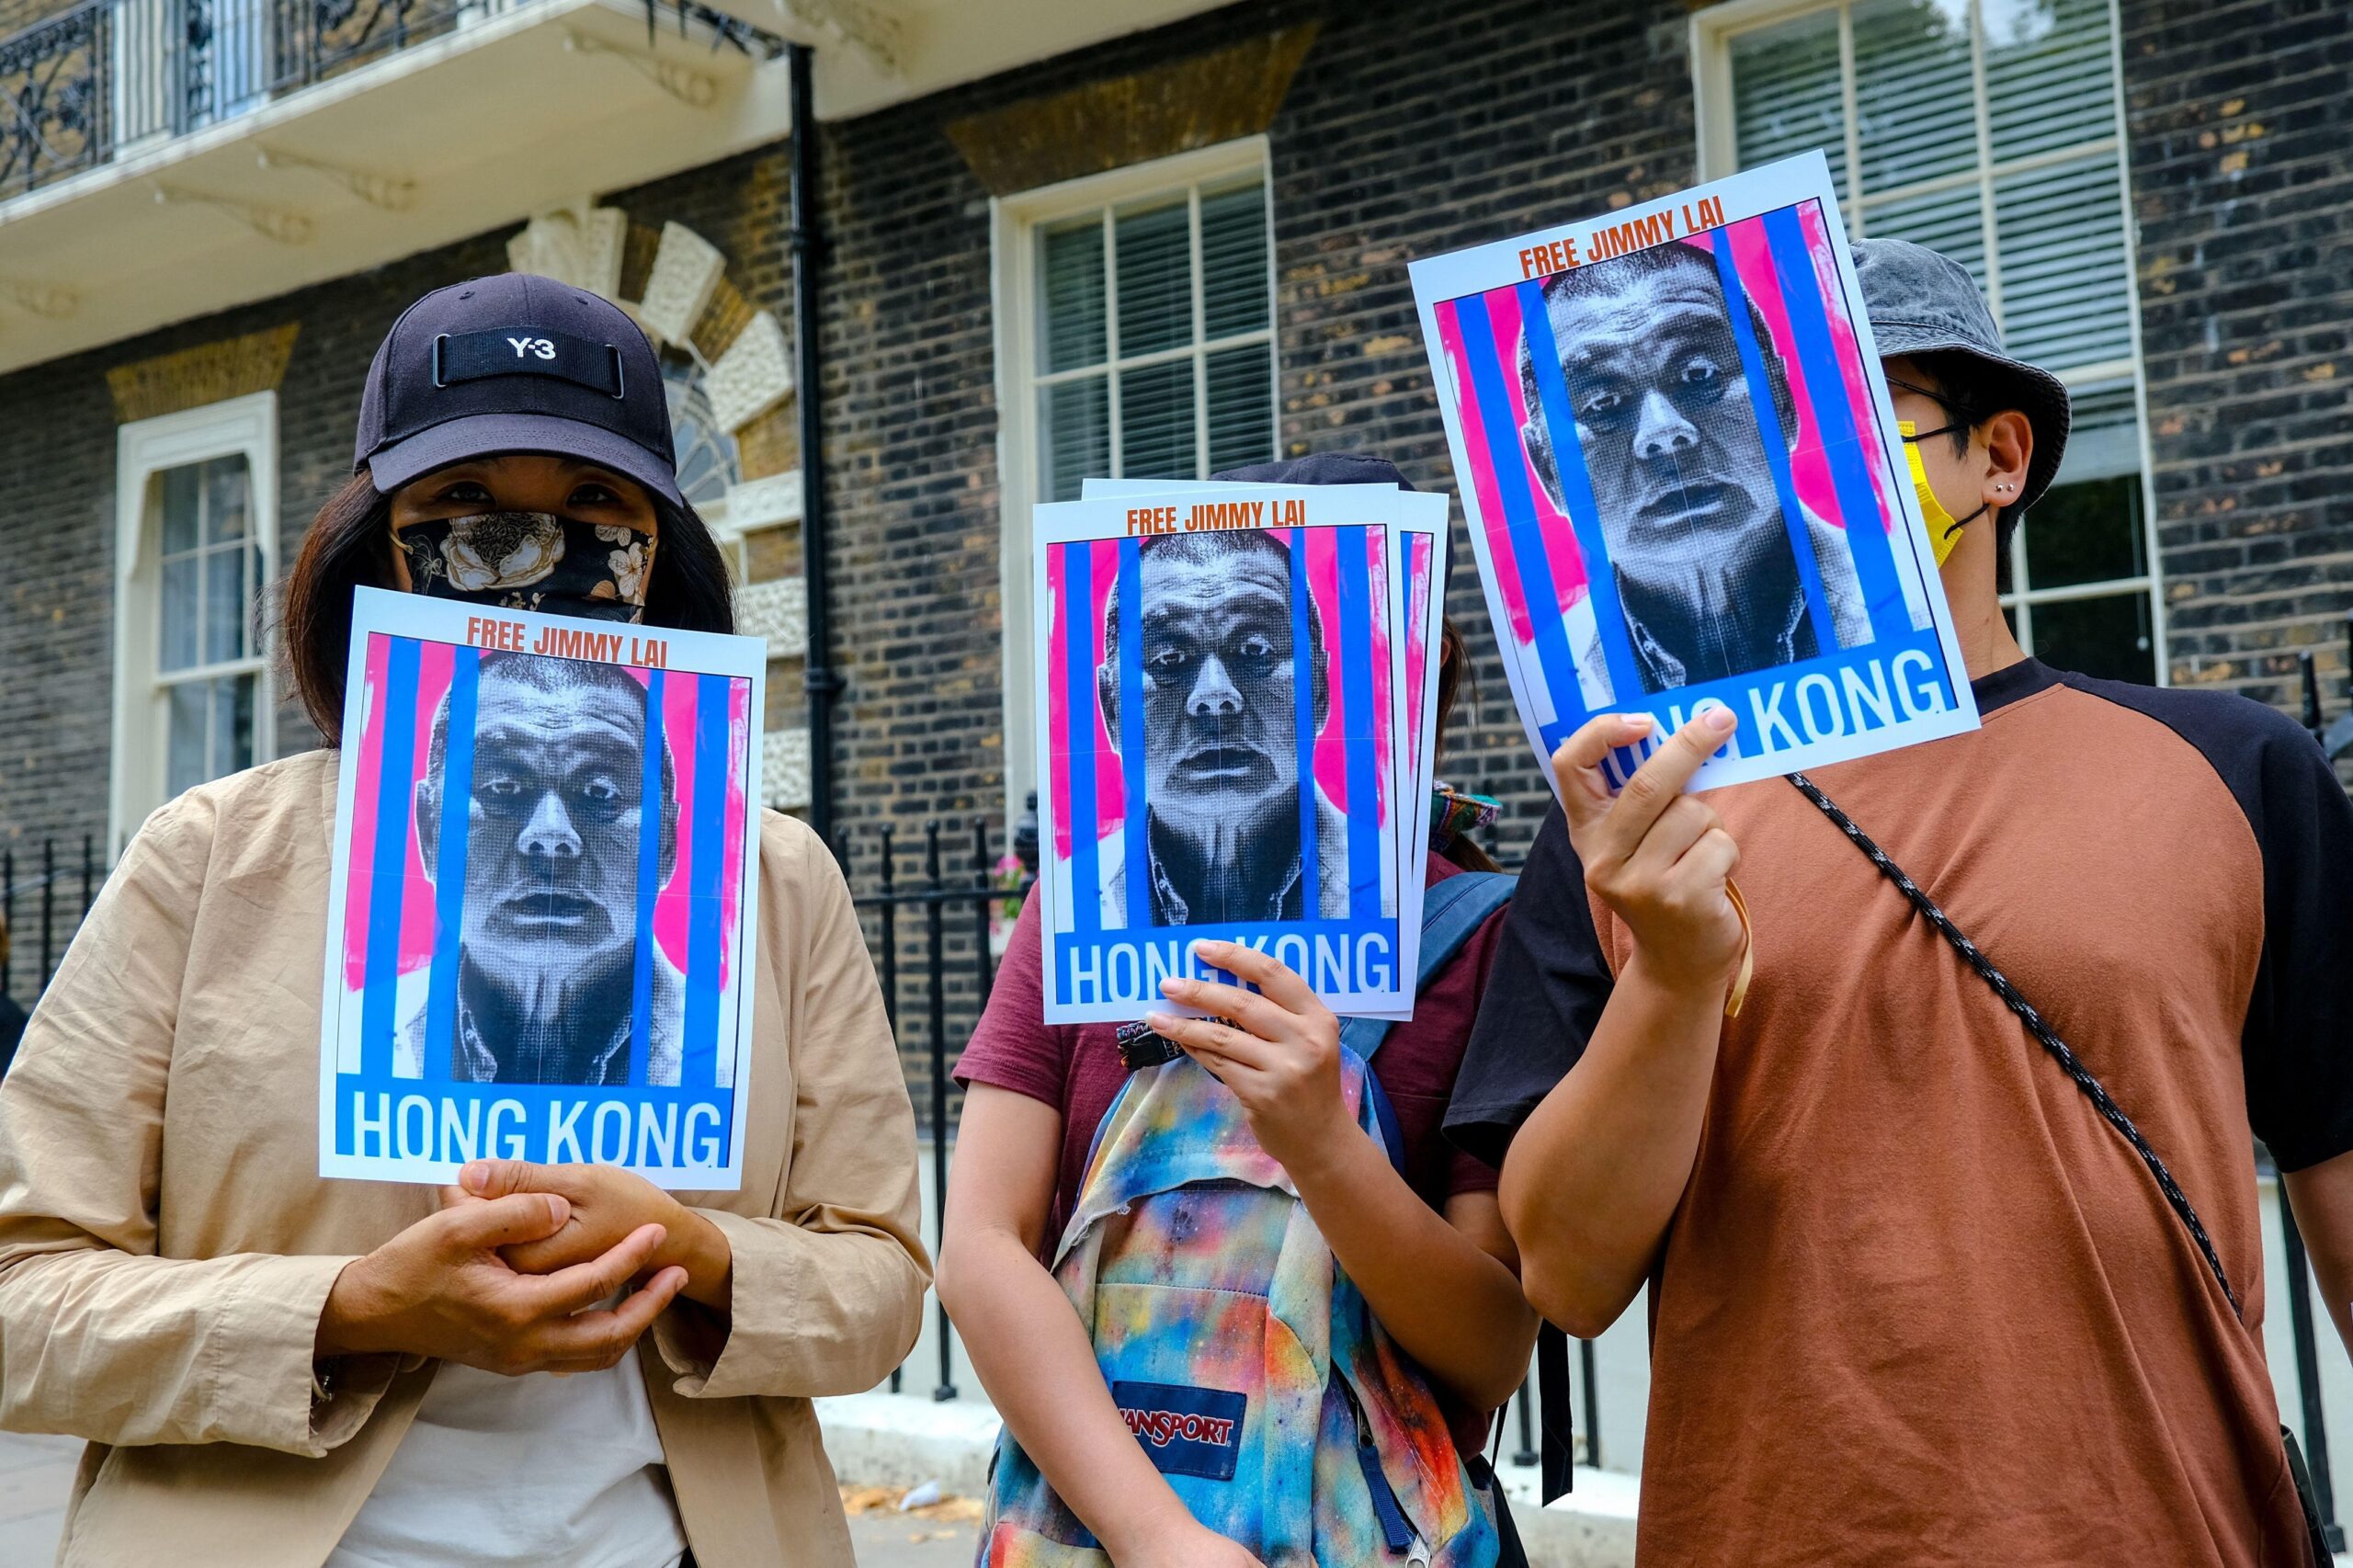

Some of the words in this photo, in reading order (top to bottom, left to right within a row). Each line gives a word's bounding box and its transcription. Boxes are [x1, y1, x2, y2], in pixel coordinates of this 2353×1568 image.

[1518, 237, 1581, 279] FREE
[1586, 210, 1675, 262] JIMMY
[1682, 195, 1725, 234] LAI
[506, 337, 556, 359] Y-3
[1127, 506, 1177, 536] FREE
[1185, 501, 1264, 532] JIMMY
[1271, 499, 1306, 527] LAI
[467, 616, 526, 653] FREE
[533, 626, 623, 664] JIMMY
[631, 637, 668, 668] LAI
[1748, 648, 1946, 752] KONG
[353, 1090, 528, 1165] HONG
[546, 1099, 722, 1168] KONG
[1119, 1407, 1234, 1447] ANSPORT
